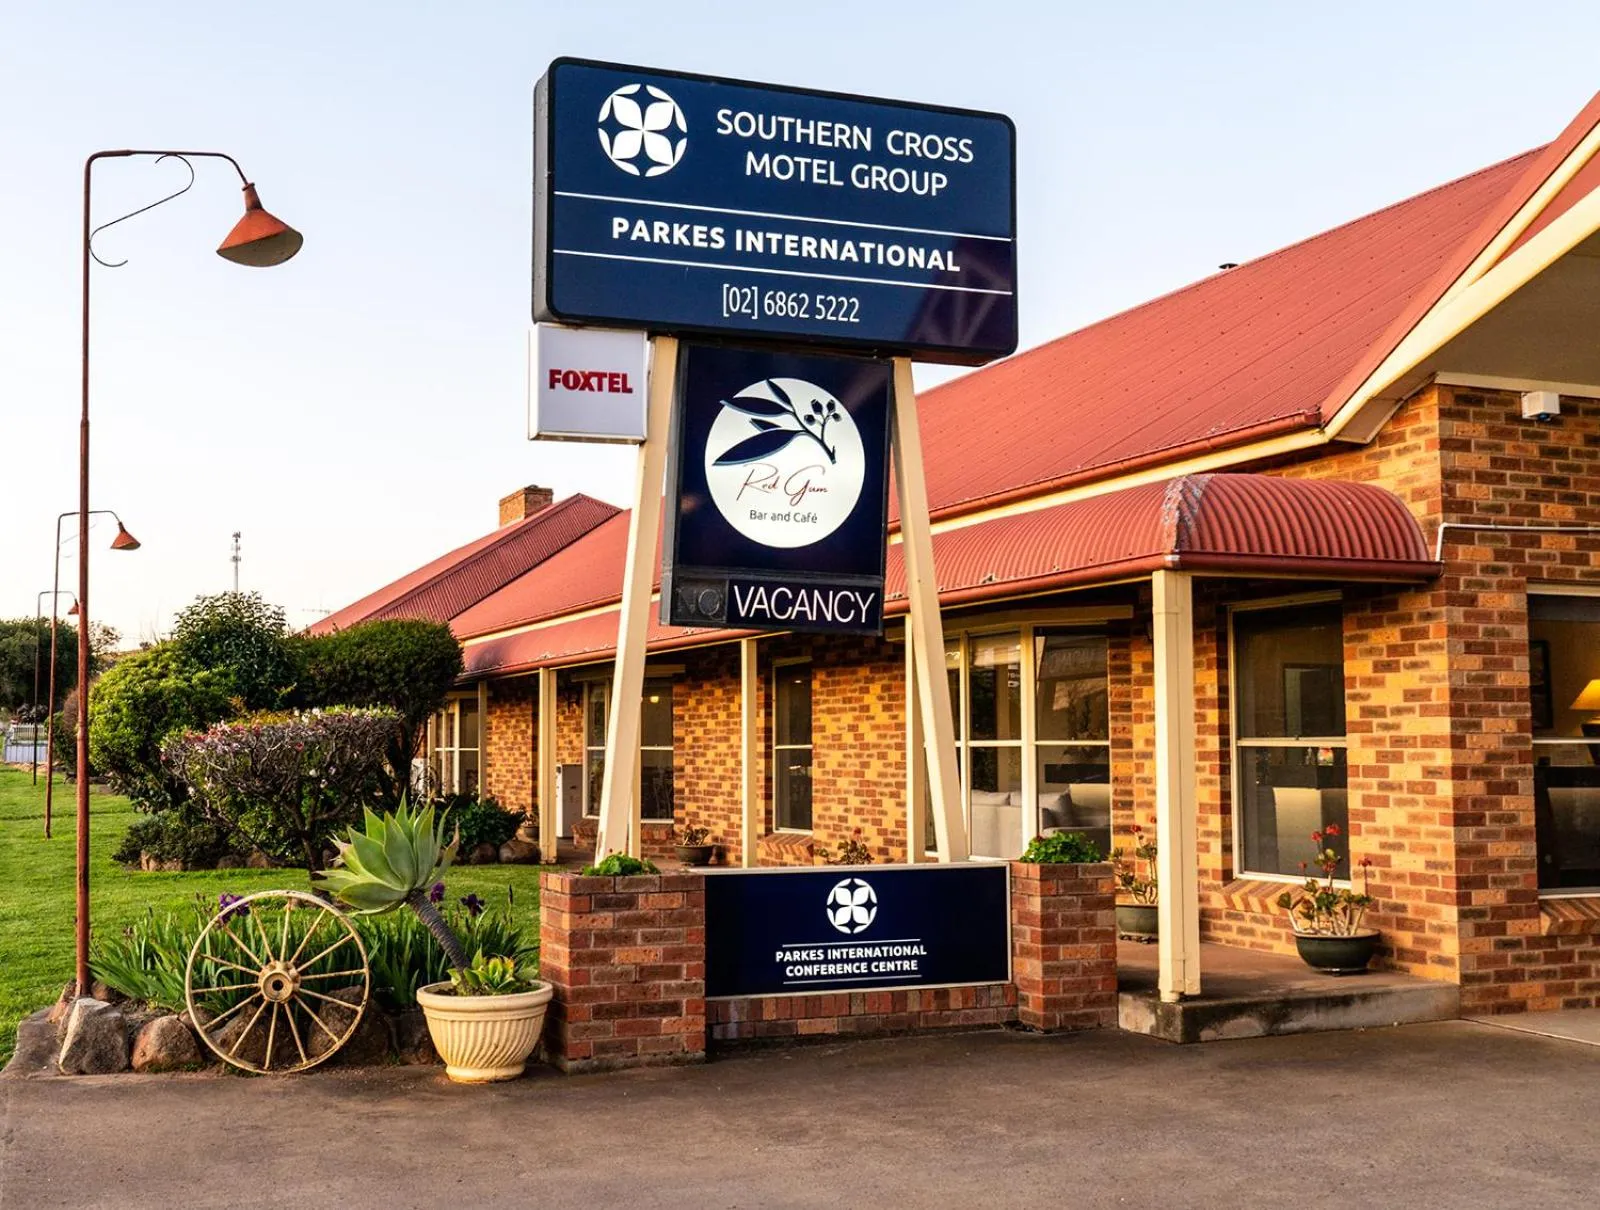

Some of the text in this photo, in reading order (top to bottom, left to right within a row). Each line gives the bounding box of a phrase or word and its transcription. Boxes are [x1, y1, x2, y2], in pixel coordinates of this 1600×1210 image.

[716, 108, 974, 163] SOUTHERN CROSS
[745, 151, 948, 196] MOTEL GROUP
[612, 217, 961, 273] PARKES INTERNATIONAL
[722, 283, 860, 323] [02] 6862 5222
[548, 368, 633, 394] FOXTEL
[736, 462, 829, 507] Red Gum
[749, 509, 818, 524] Bar and Café
[733, 585, 875, 623] VACANCY
[775, 945, 927, 963] PARKES INTERNATIONAL
[785, 959, 918, 977] CONFERENCE CENTRE
